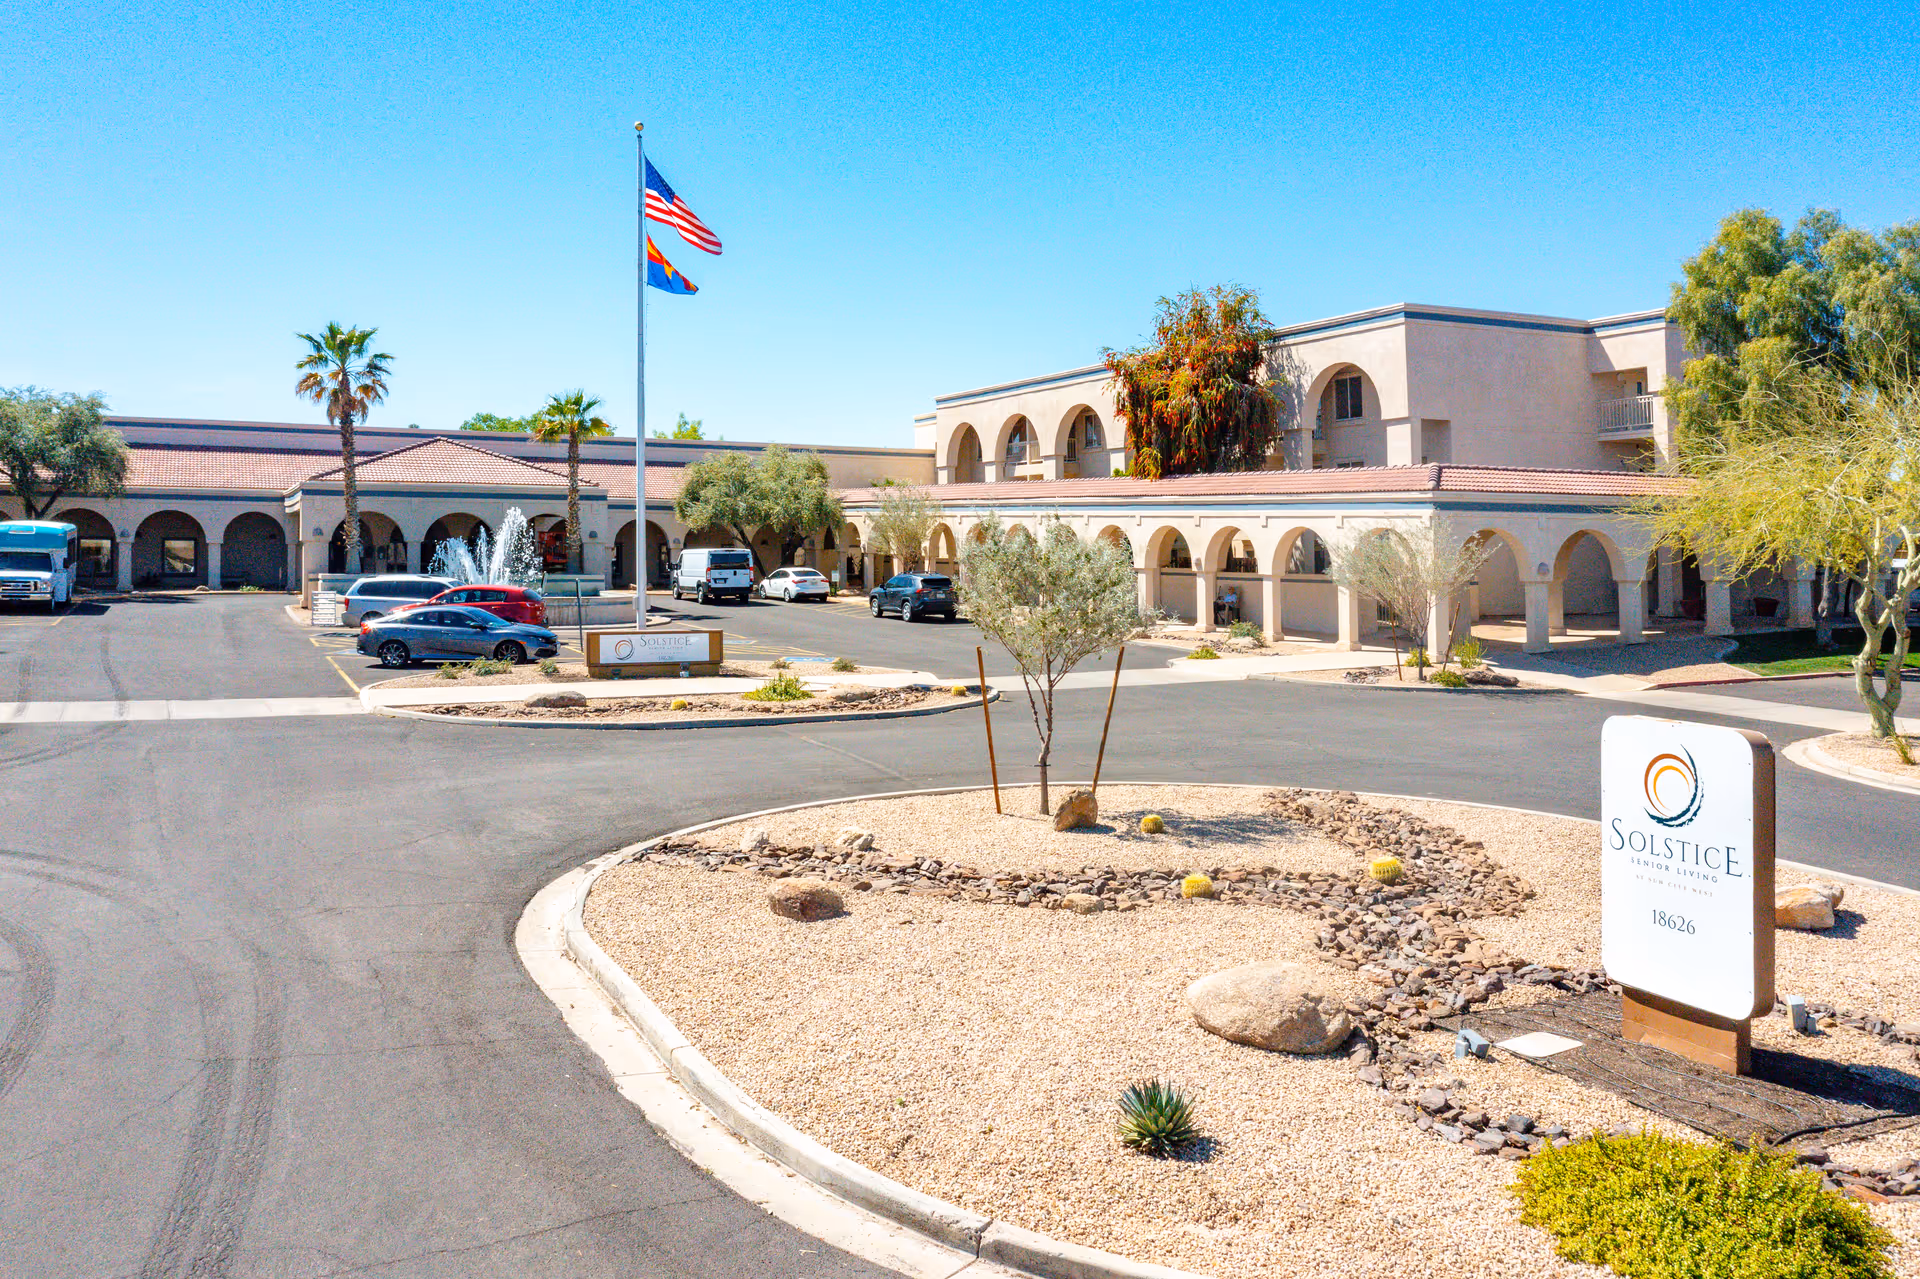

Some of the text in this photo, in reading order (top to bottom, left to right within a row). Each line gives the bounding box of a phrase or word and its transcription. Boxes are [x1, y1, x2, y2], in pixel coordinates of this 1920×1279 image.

[639, 633, 692, 647] SOLSTICE
[1609, 817, 1743, 878] SOLSTICE
[1630, 857, 1718, 884] SENIOR LIVING
[1652, 908, 1696, 935] 18626
